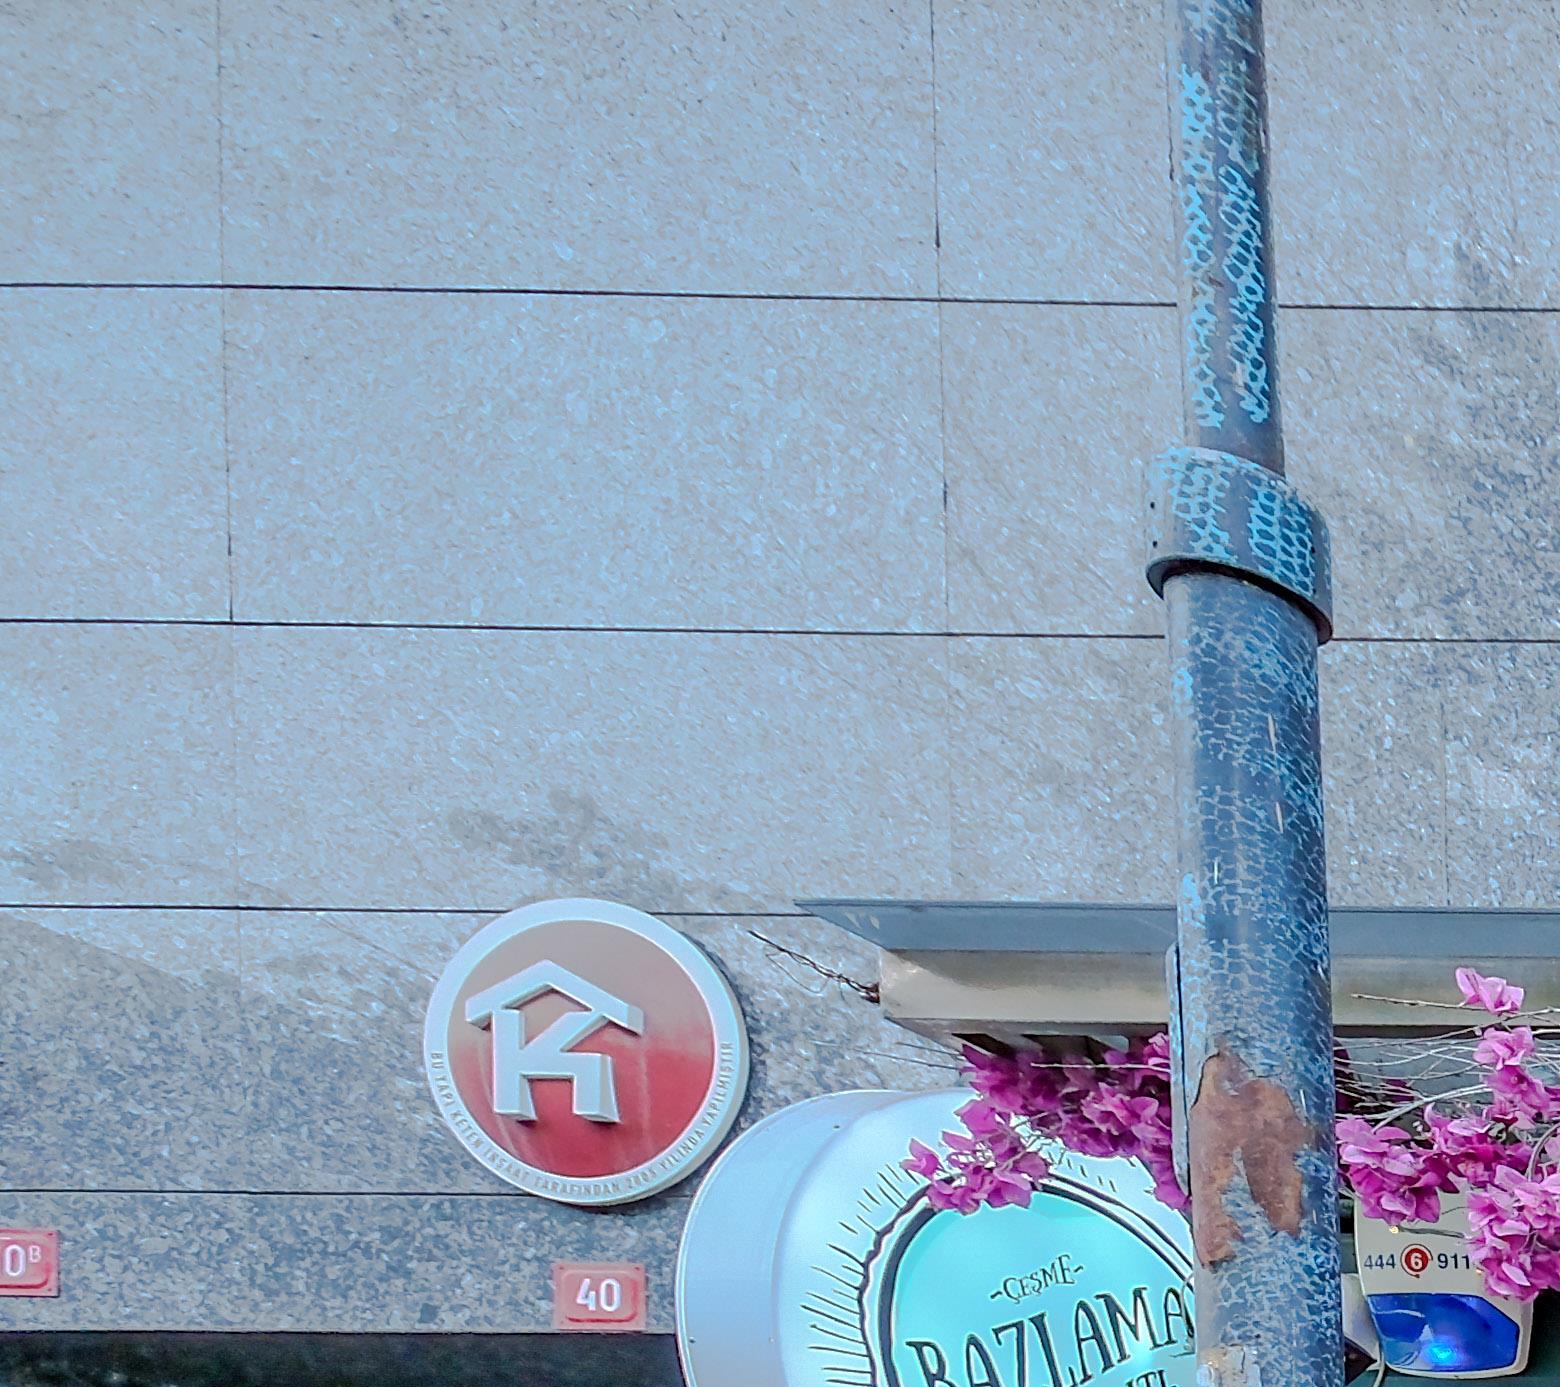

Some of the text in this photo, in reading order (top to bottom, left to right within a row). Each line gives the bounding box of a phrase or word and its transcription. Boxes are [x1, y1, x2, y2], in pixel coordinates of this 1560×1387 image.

[430, 1052, 444, 1070] BU
[1363, 1251, 1471, 1270] 444 6 911
[1002, 1253, 1076, 1304] ÇEŞME
[575, 1277, 622, 1314] 40
